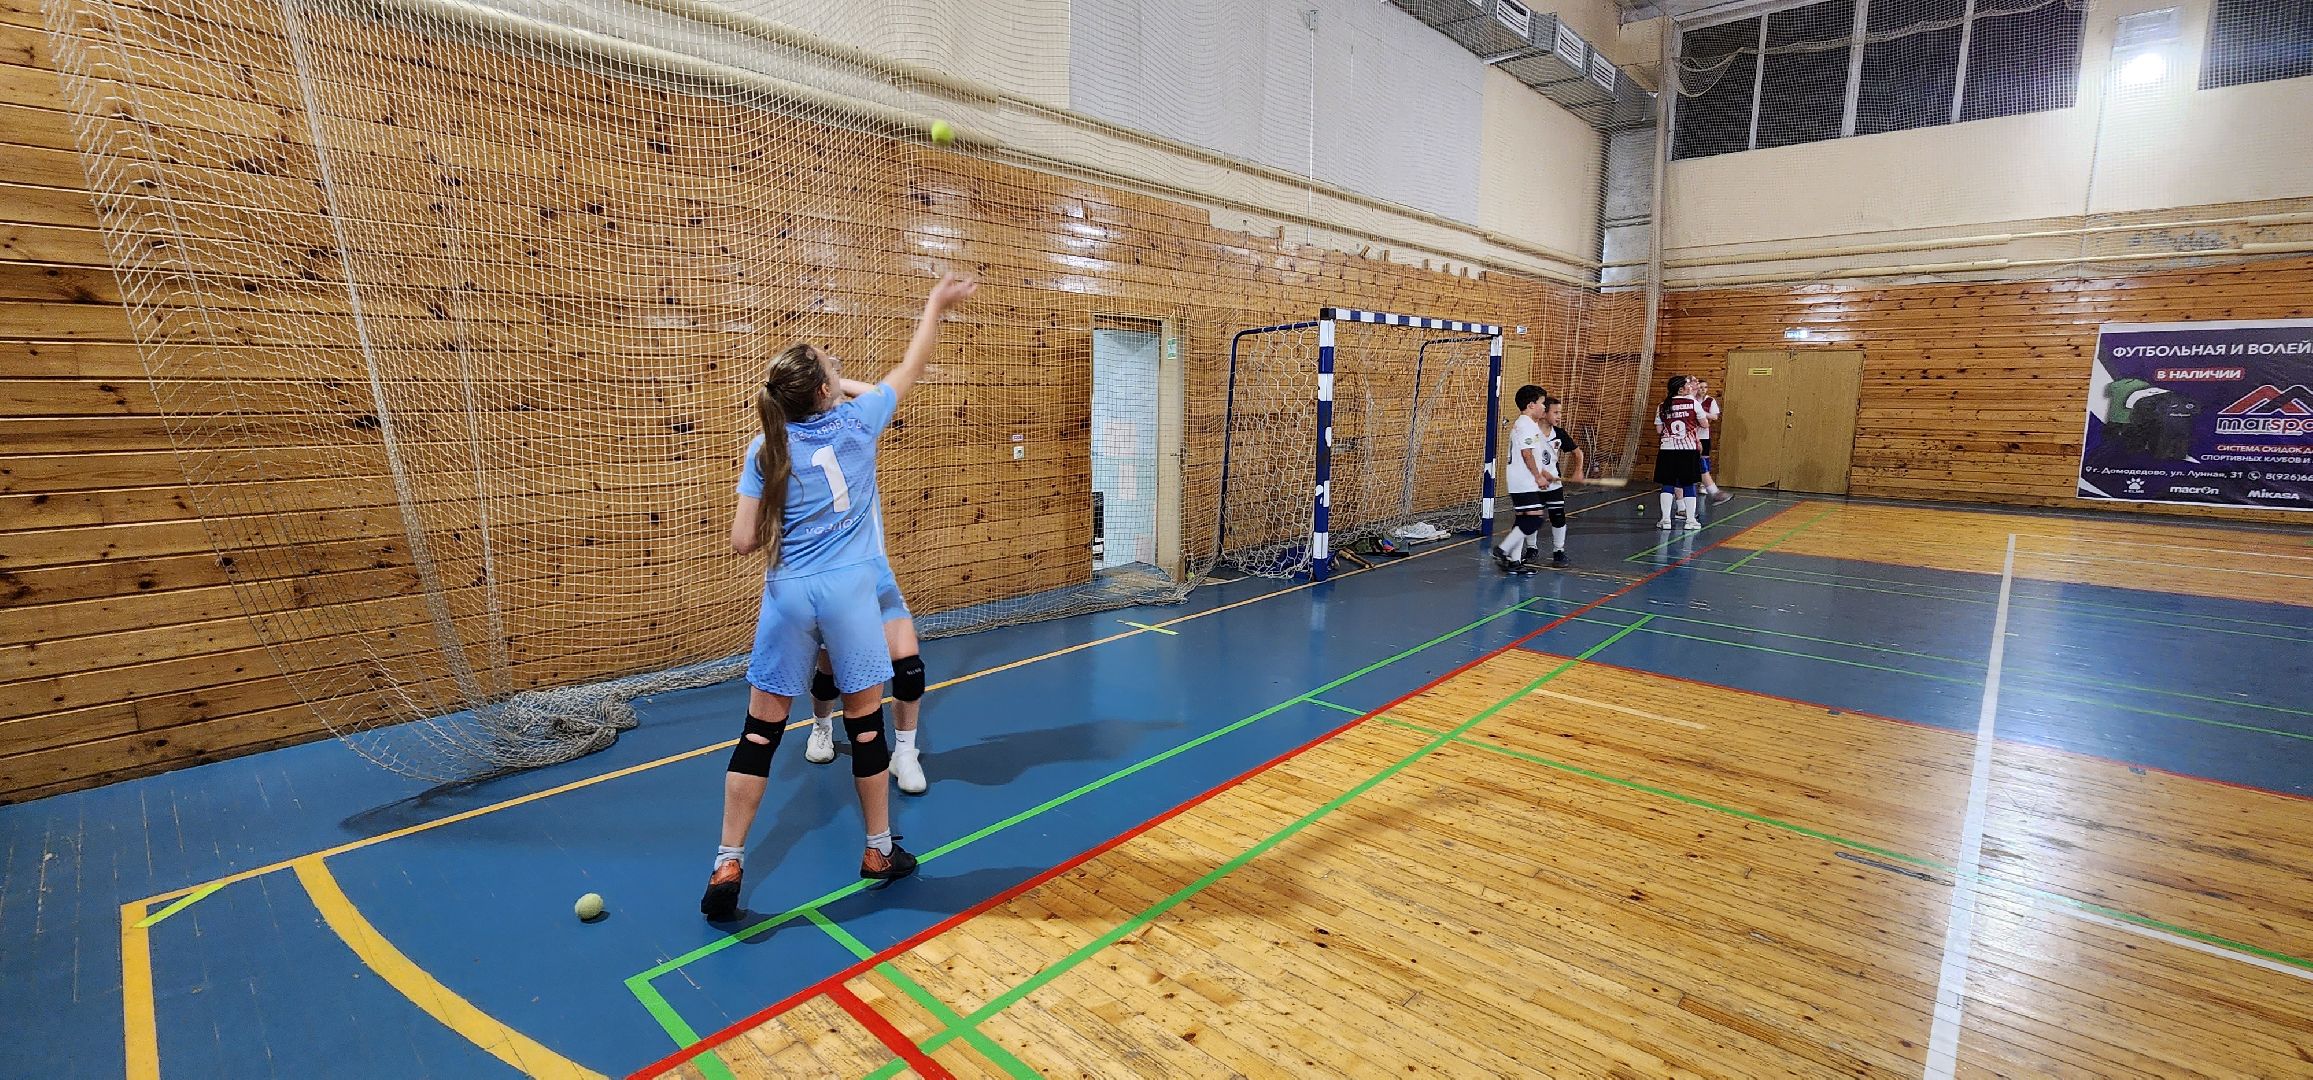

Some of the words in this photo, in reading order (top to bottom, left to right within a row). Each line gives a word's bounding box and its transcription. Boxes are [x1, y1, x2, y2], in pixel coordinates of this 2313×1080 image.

[2113, 343, 2226, 358] ФУТБОЛЬНАЯ
[2228, 343, 2243, 355] И
[2247, 339, 2313, 355] ВОЛЕЙ
[2157, 370, 2164, 379] В
[2169, 369, 2241, 379] НАЛИЧИИ
[1670, 420, 1686, 438] 9
[2201, 454, 2262, 462] СПОРТИВНЫХ
[810, 444, 851, 513] 1
[2102, 467, 2168, 477] Домодедово,
[2188, 470, 2227, 479] Лунная,
[2170, 486, 2219, 495] macron
